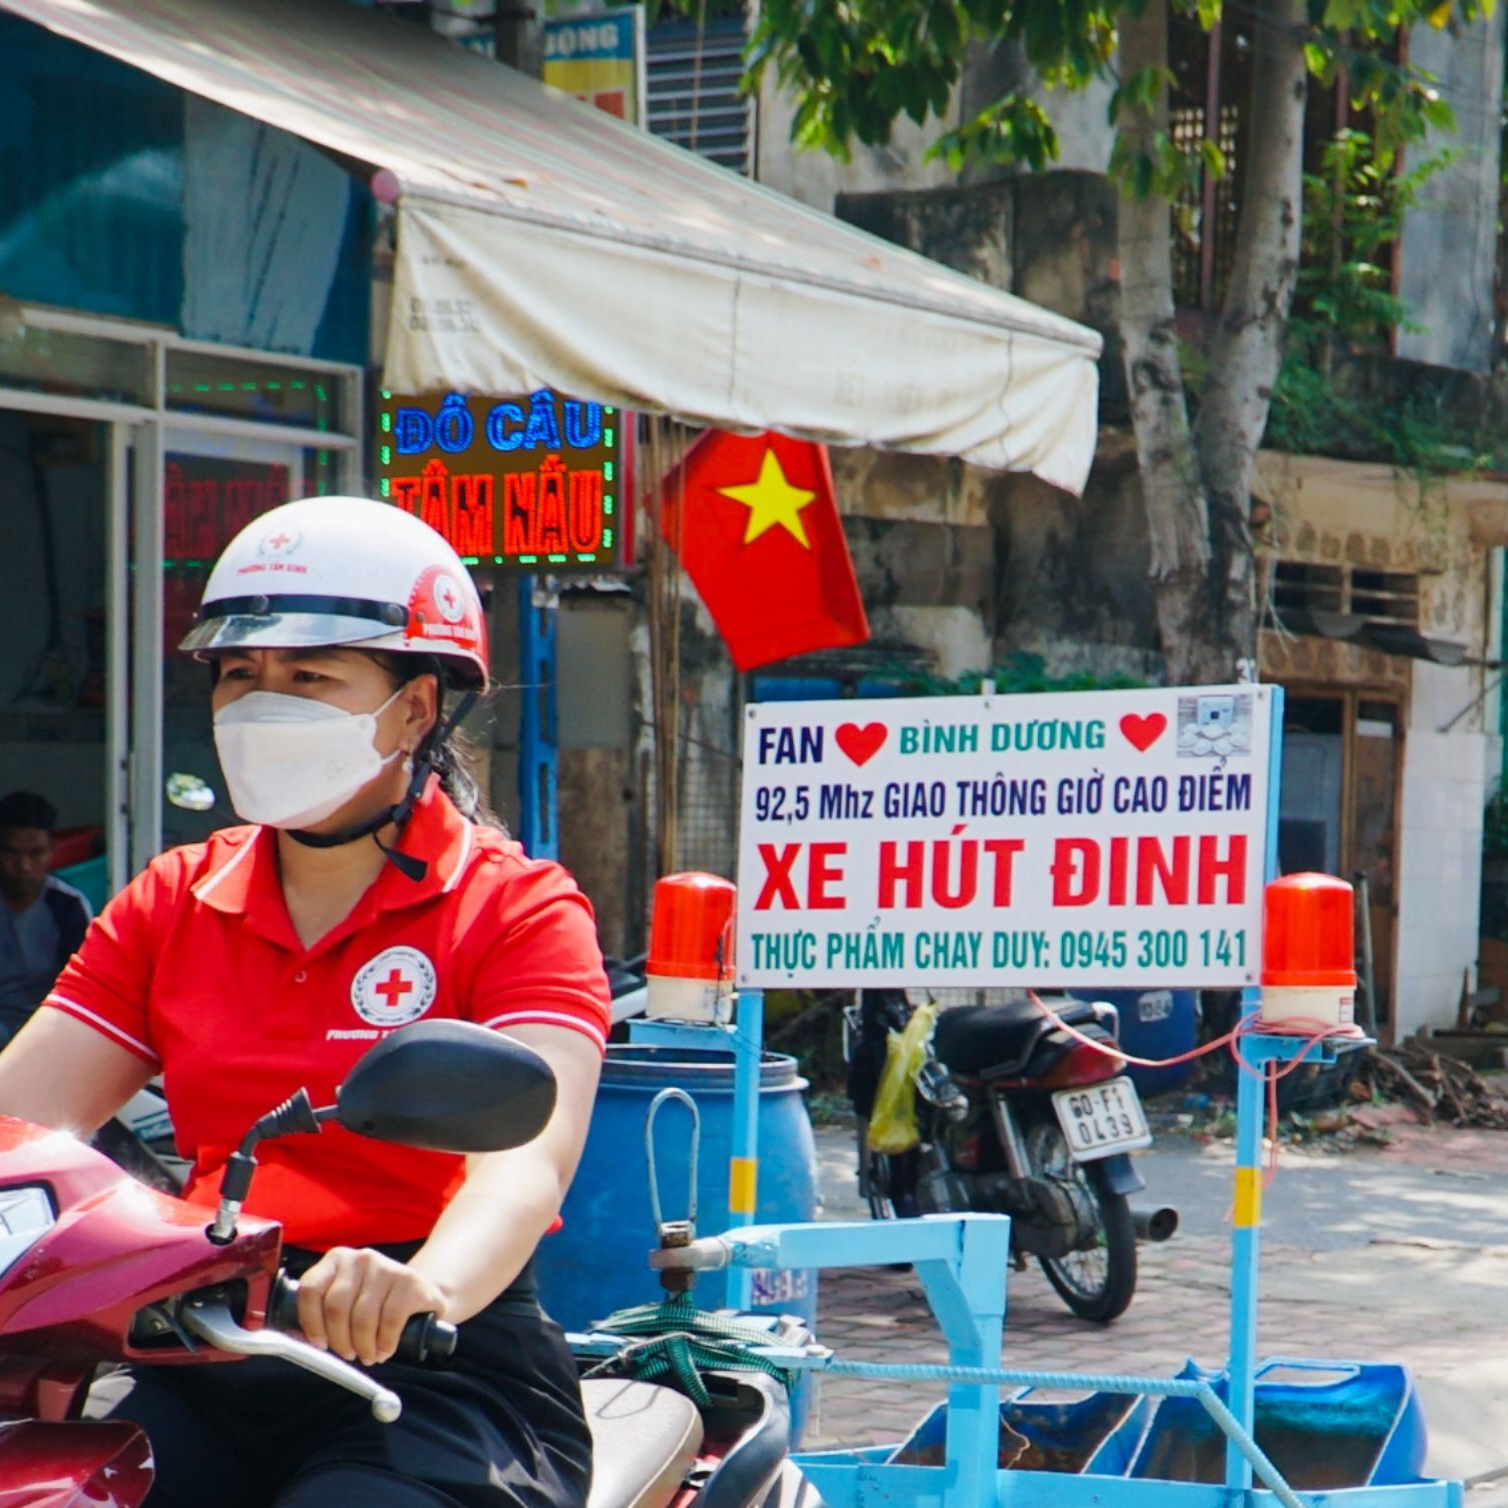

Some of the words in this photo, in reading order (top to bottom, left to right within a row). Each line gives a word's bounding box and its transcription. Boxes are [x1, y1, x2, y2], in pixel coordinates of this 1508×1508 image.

[487, 388, 601, 451] CÂU
[758, 725, 824, 765] FAN
[899, 719, 979, 754] BÌNH
[991, 719, 1106, 753] DƯƠNG
[755, 784, 810, 824] 92,5
[819, 784, 874, 820] Mhz
[884, 781, 946, 818] GIAO
[956, 772, 1047, 816] THÔNG
[1057, 768, 1105, 814] GIỜ
[1115, 774, 1168, 812] CAO
[1178, 756, 1253, 812] ĐIỂM
[753, 842, 848, 911] XE
[877, 823, 1025, 909] HÚT
[1050, 834, 1248, 907] ĐINH
[751, 931, 816, 979] THỰC
[827, 916, 904, 970] PHẨM
[915, 932, 982, 968] CHAY
[993, 931, 1051, 968] DUY:
[1060, 930, 1127, 968] 0945
[1137, 930, 1188, 967] 300
[1199, 930, 1247, 967] 141
